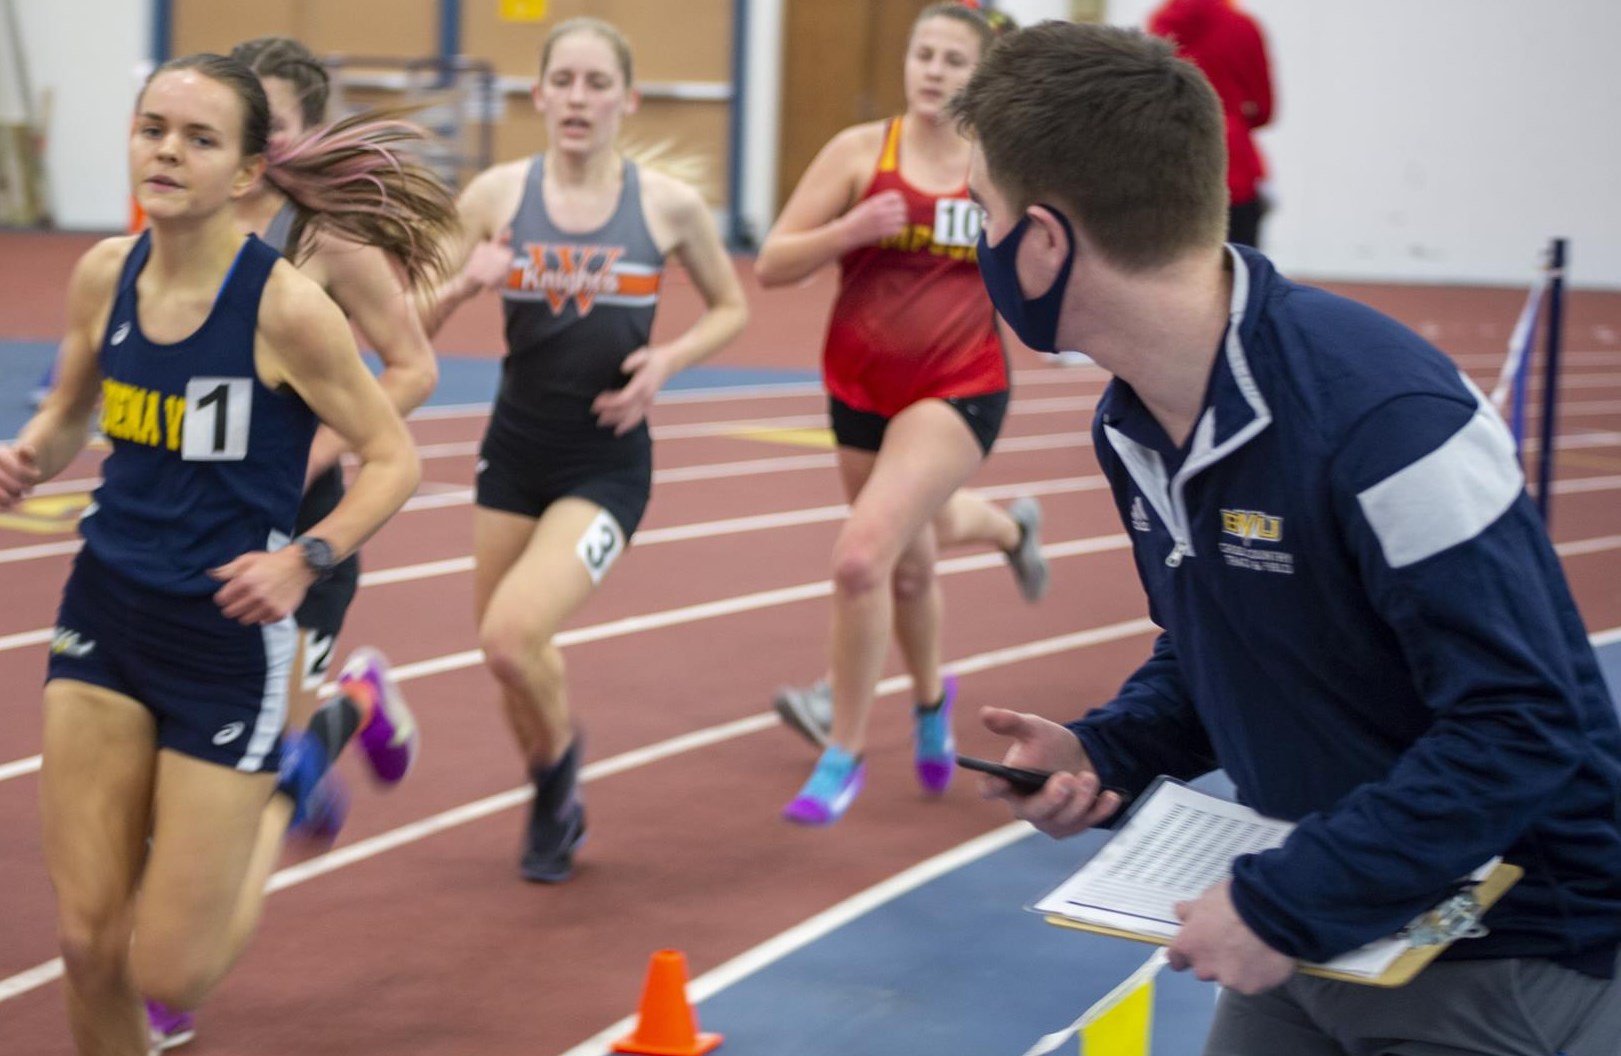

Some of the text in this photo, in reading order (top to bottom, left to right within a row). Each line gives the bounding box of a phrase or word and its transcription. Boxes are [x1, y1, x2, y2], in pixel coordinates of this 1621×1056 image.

[942, 204, 983, 243] 10
[521, 266, 619, 297] Knights
[522, 243, 627, 318] W
[196, 382, 231, 454] 1
[586, 525, 616, 570] 3
